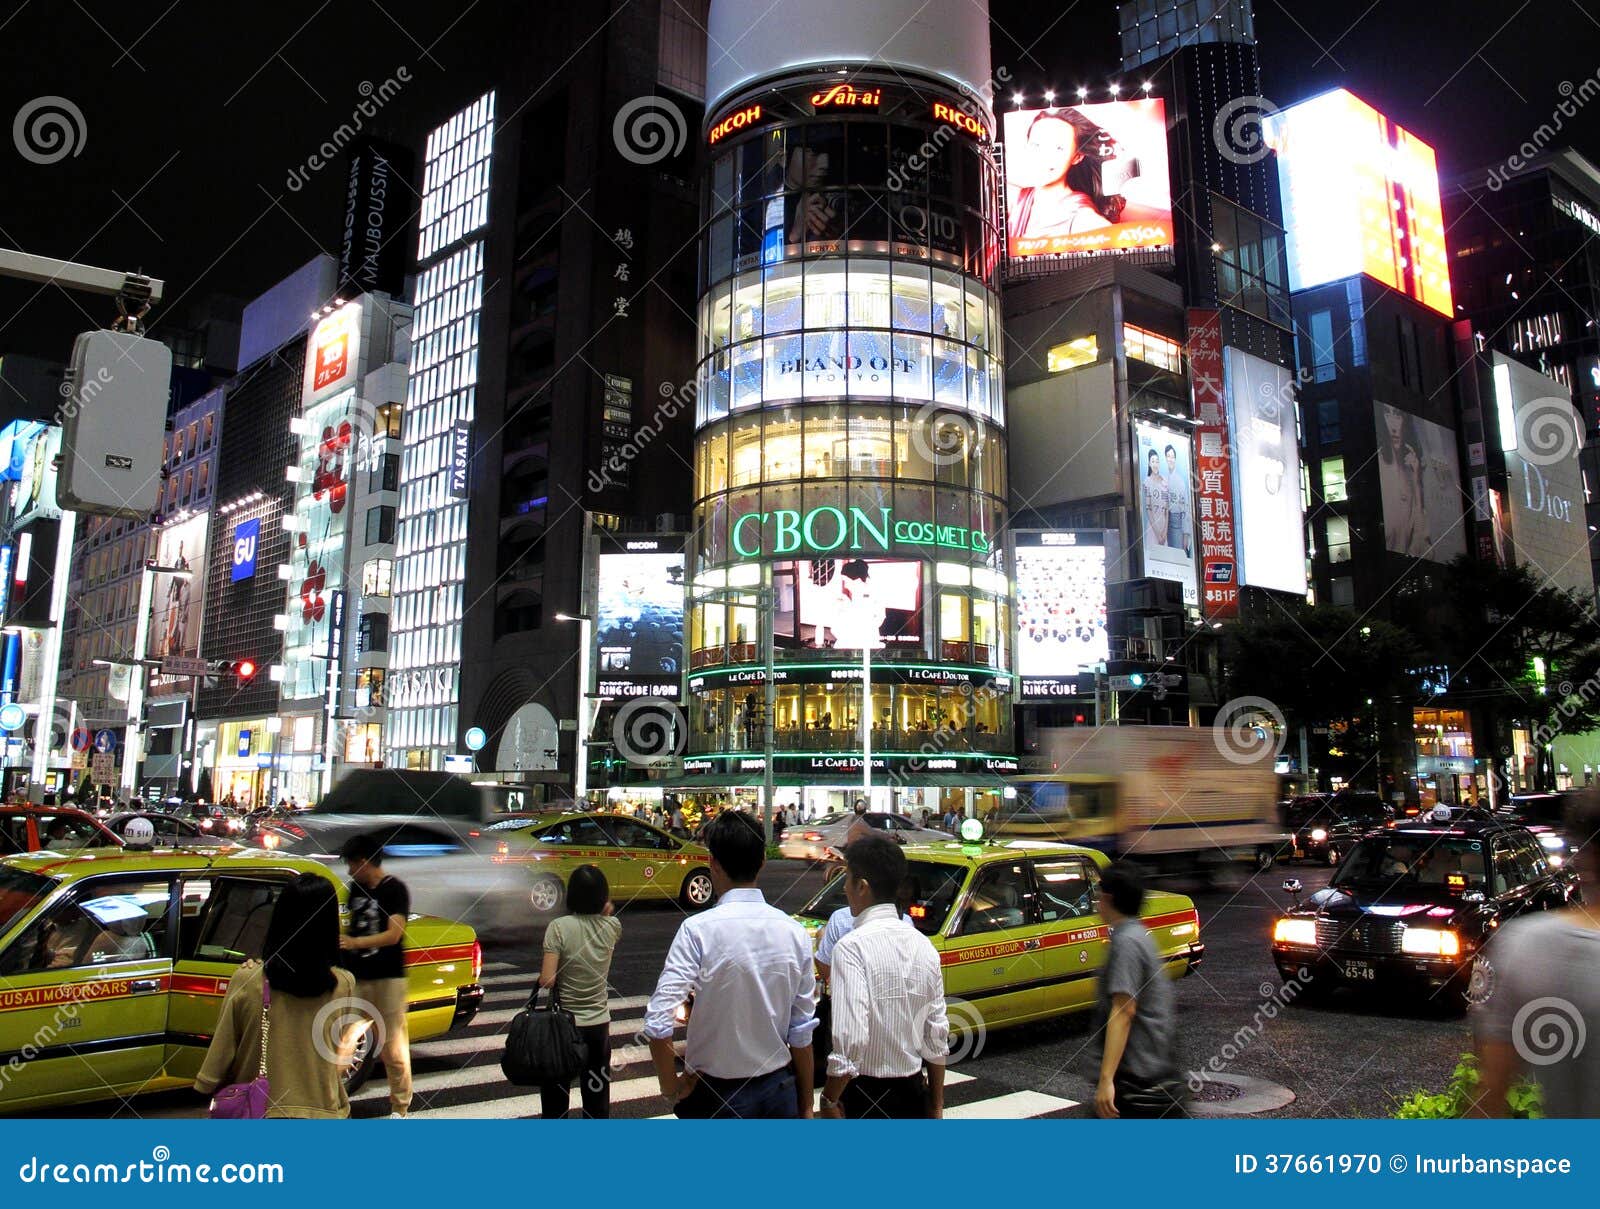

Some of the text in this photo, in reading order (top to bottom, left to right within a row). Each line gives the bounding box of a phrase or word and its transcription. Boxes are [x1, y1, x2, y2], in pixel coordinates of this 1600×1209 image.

[811, 84, 880, 107] San-ai
[710, 105, 761, 144] RICOH
[934, 102, 986, 140] RICOH
[362, 155, 388, 284] MAUBOUSSIN
[739, 255, 758, 267] ENTAX
[614, 229, 633, 317] 鳩居堂
[1188, 327, 1219, 339] ブランド
[1191, 348, 1220, 361] チケット
[780, 355, 917, 375] BRAND OFF
[454, 427, 469, 490] TASAKI
[1519, 459, 1572, 523] Dior
[1200, 498, 1230, 518] 買取
[733, 506, 989, 557] C'BON COSMETCS
[1201, 521, 1232, 543] 販売
[232, 539, 256, 566] GU
[1215, 589, 1236, 602] B1F
[389, 668, 453, 697] TASAKI
[757, 670, 788, 680] DOTOR
[599, 685, 622, 696] RING
[623, 685, 648, 696] CUBE
[1023, 685, 1077, 695] RING CUBE
[850, 757, 885, 768] DOTOR
[958, 949, 994, 961] KOKUSAI
[994, 942, 1020, 955] GROUP
[1345, 967, 1375, 980] 65-48
[44, 981, 128, 1001] MOTORCARS
